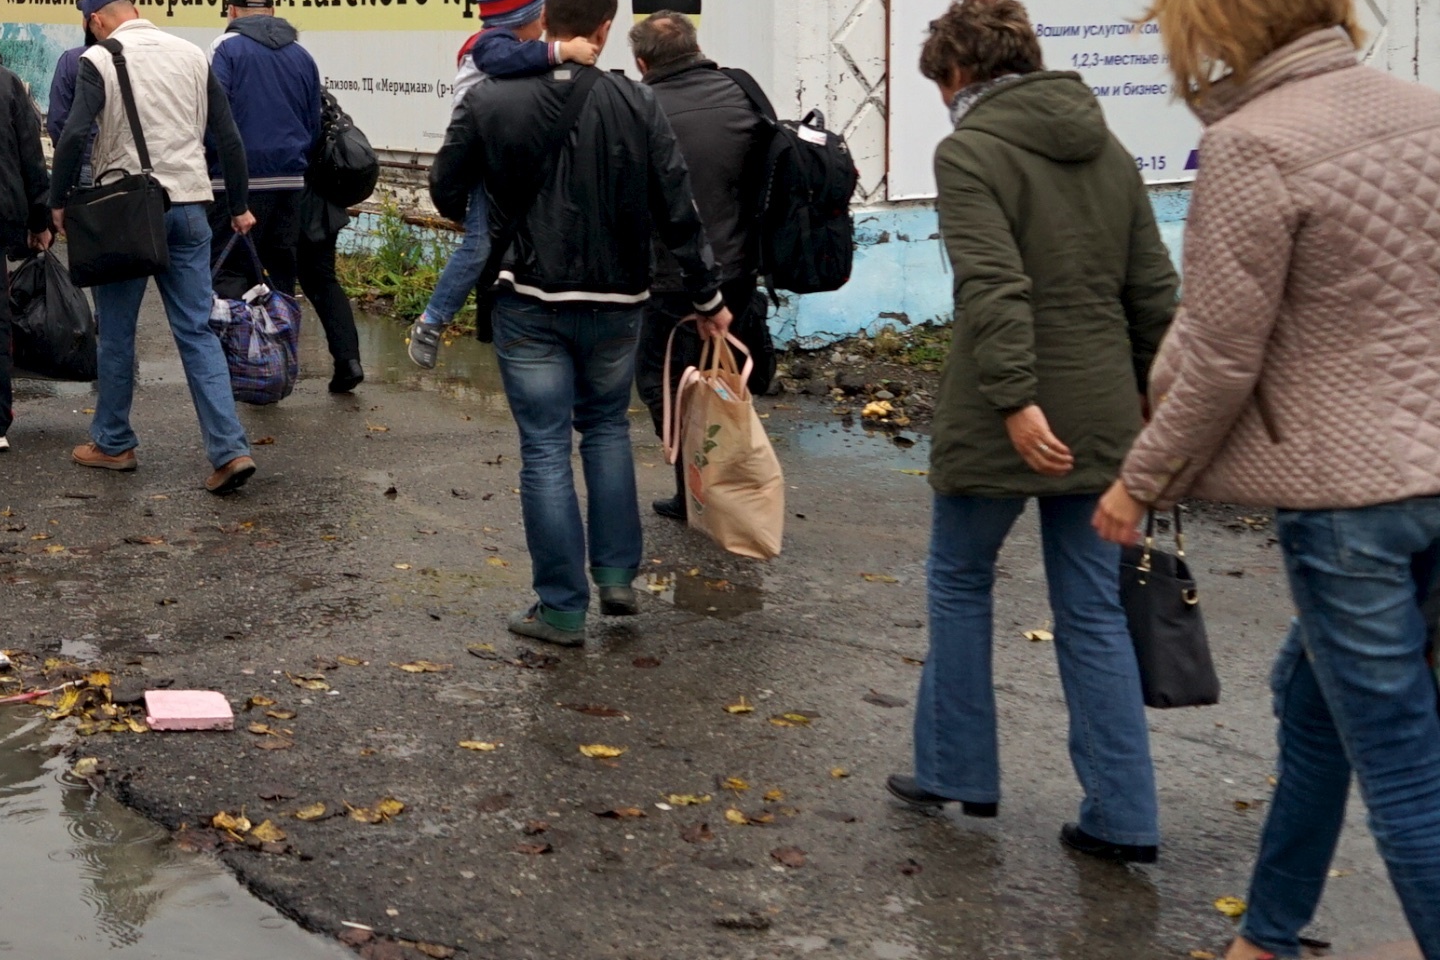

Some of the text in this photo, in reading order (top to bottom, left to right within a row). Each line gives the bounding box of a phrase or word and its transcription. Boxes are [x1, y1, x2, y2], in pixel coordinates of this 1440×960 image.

[1035, 23, 1080, 37] Вашим
[1083, 23, 1135, 39] услугам
[1071, 53, 1159, 69] 1,2,3-местные
[324, 77, 360, 92] Елизово,
[362, 77, 373, 94] ТЦ
[375, 78, 433, 96] «Меридиан»
[1112, 85, 1120, 96] и
[1123, 82, 1168, 97] бизнес
